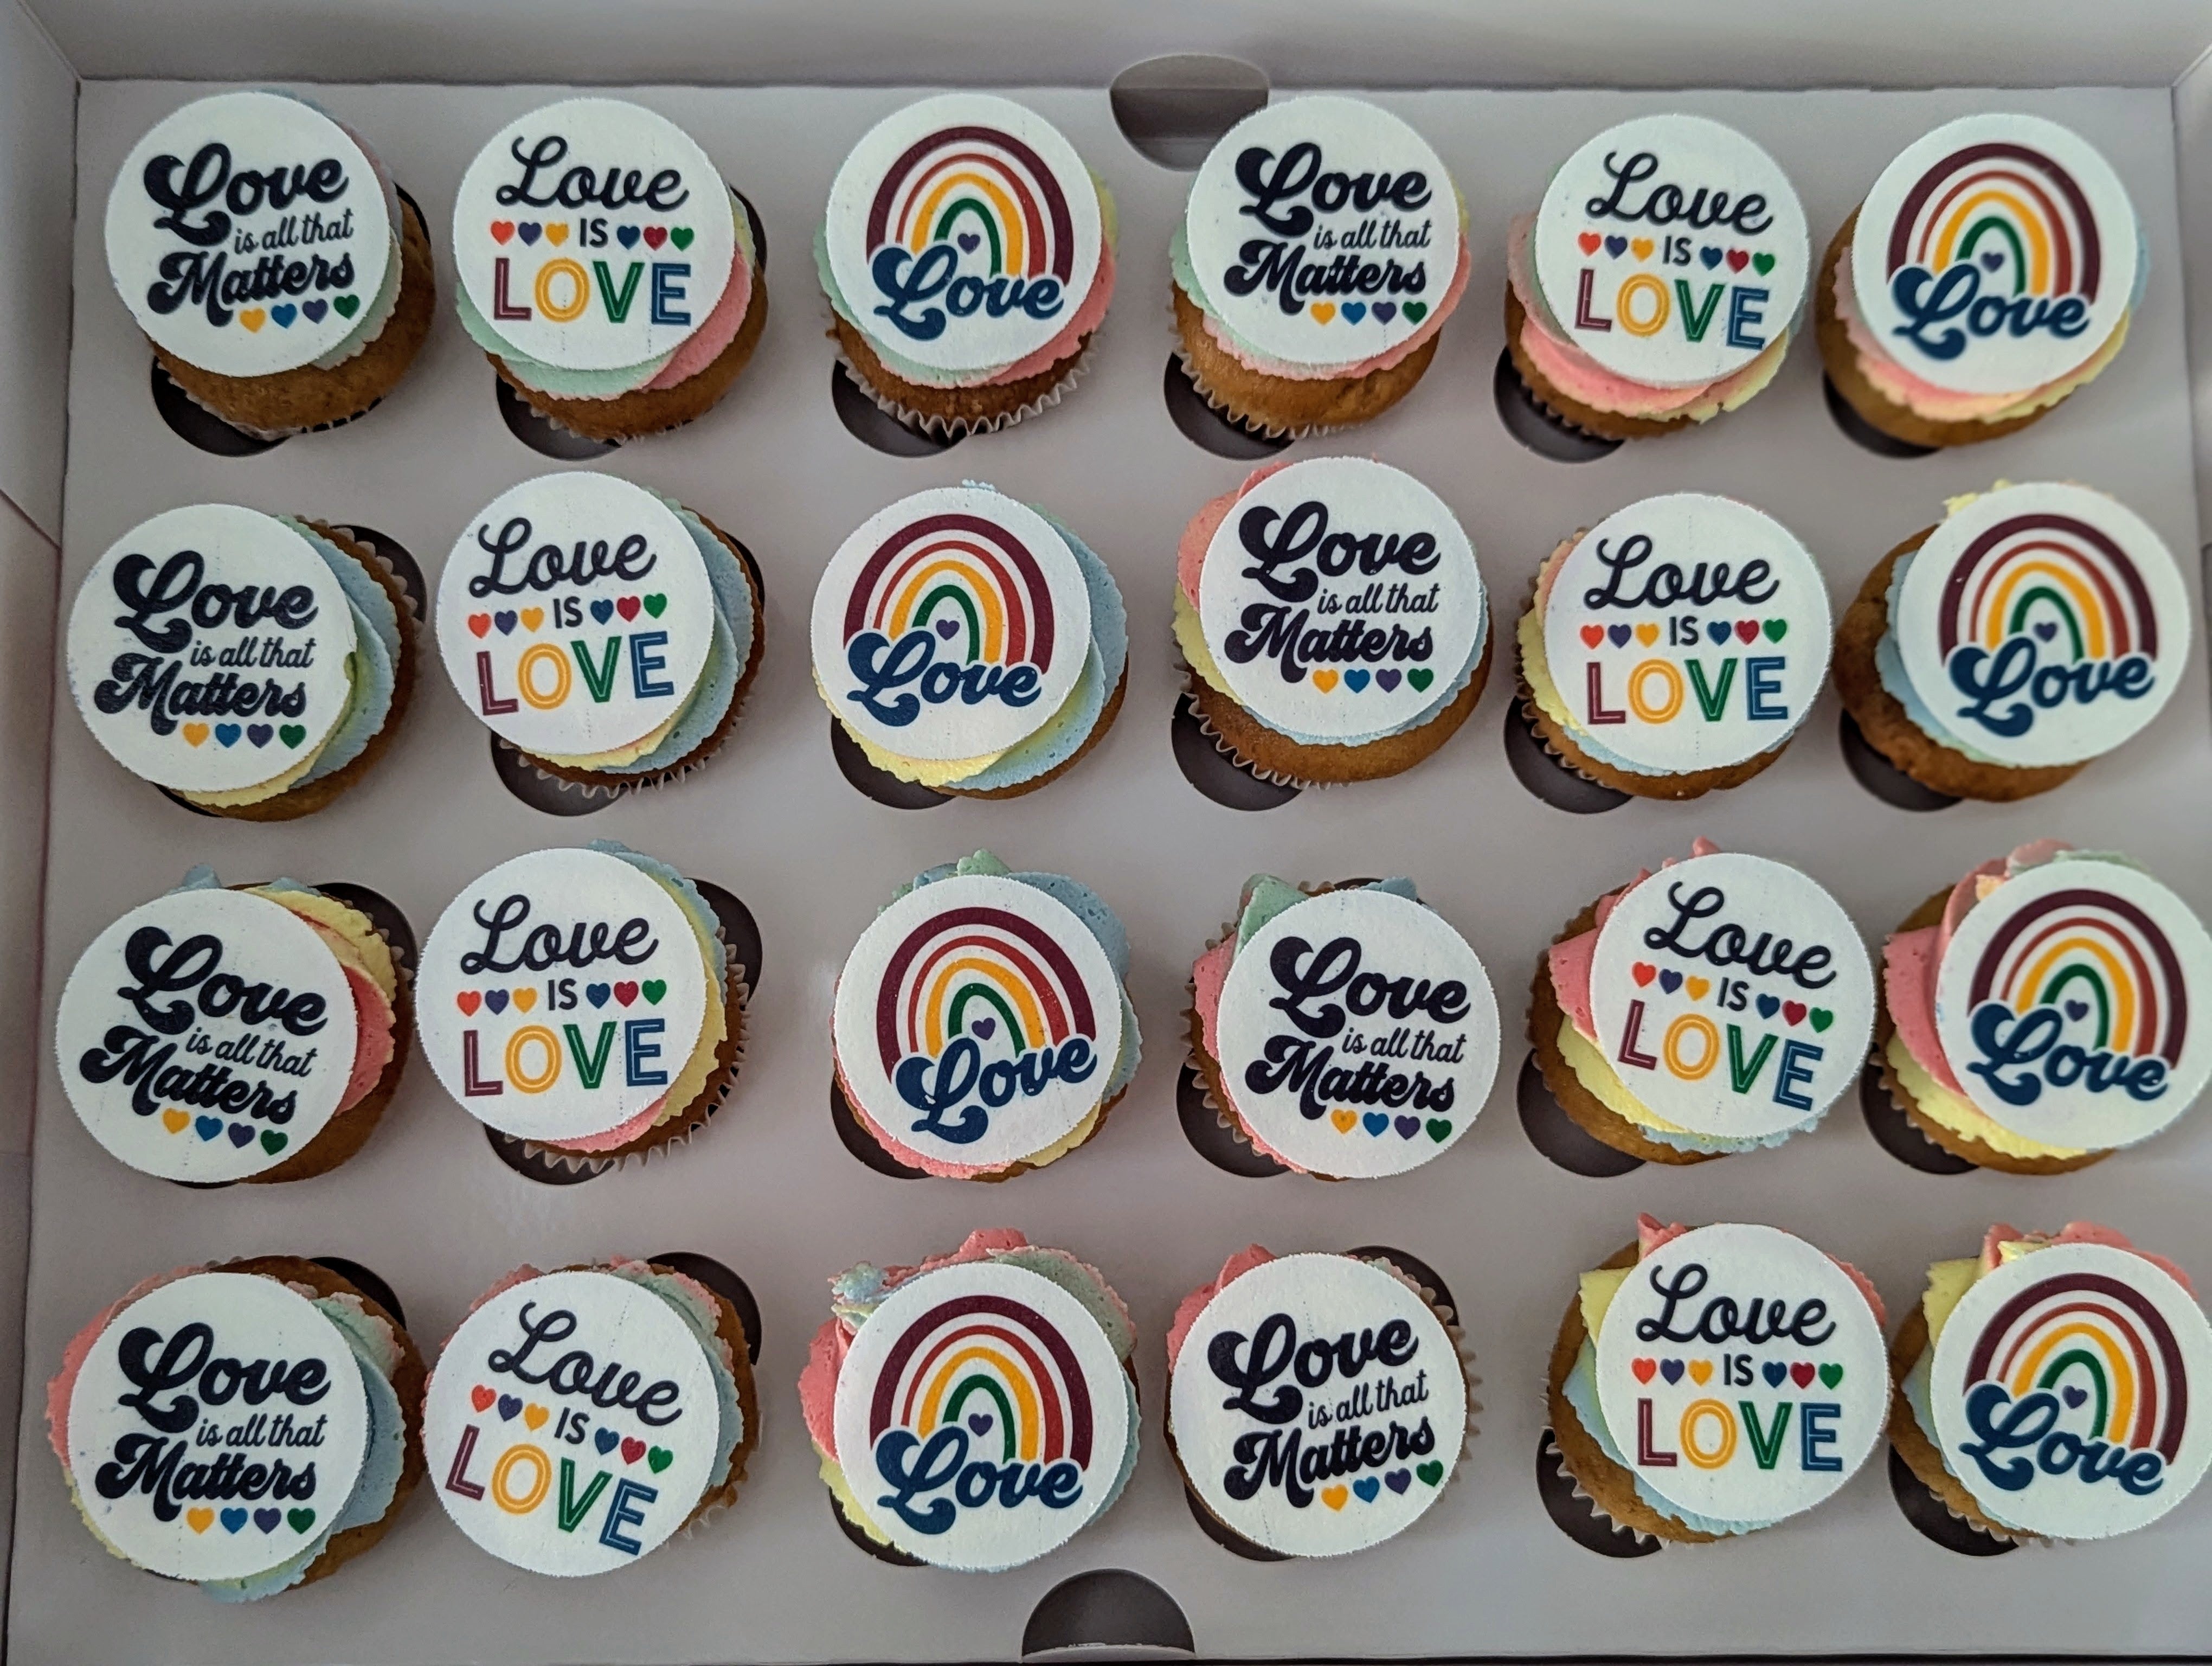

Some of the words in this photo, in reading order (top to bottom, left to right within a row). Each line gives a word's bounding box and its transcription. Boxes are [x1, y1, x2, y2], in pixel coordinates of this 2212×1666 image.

[143, 143, 349, 247] Love
[496, 136, 689, 212] Love
[1235, 142, 1432, 239] Love
[1586, 152, 1773, 236] Love
[234, 228, 259, 255] is
[261, 215, 299, 251] all
[301, 208, 353, 245] that
[580, 218, 608, 248] IS
[1314, 225, 1338, 249] is
[1341, 220, 1377, 249] all
[1380, 219, 1431, 248] that
[1663, 236, 1692, 266] IS
[147, 251, 355, 327] Matters
[494, 258, 691, 326] LOVE
[872, 245, 1064, 341] Love
[1224, 239, 1426, 316] Matters
[1576, 268, 1770, 350] LOVE
[1892, 263, 2089, 361] Love
[469, 517, 657, 598] Love
[1239, 501, 1441, 603] Love
[1584, 535, 1779, 610] Love
[113, 550, 318, 653] Love
[554, 596, 583, 629] IS
[1317, 588, 1342, 614] is
[1346, 583, 1383, 614] all
[1385, 583, 1440, 613] that
[1670, 616, 1699, 646] IS
[190, 640, 216, 667] is
[218, 636, 259, 667] all
[259, 637, 316, 668] that
[477, 631, 674, 715] LOVE
[847, 630, 1041, 727] Love
[1224, 603, 1433, 683] Matters
[94, 652, 306, 736] Matters
[1587, 656, 1788, 725] LOVE
[1949, 637, 2155, 738] Love
[460, 894, 659, 975] Love
[1644, 881, 1836, 989] Love
[117, 926, 328, 1036] Love
[548, 978, 577, 1010] IS
[1269, 937, 1471, 1039] Love
[1717, 977, 1750, 1011] IS
[79, 1025, 298, 1125] Matters
[185, 1027, 214, 1055] is
[214, 1033, 261, 1065] all
[256, 1039, 318, 1077] that
[464, 1018, 667, 1097] LOVE
[1245, 1035, 1455, 1120] Matters
[1342, 1027, 1367, 1054] is
[1371, 1027, 1410, 1058] all
[1410, 1030, 1467, 1063] that
[1618, 999, 1824, 1111] LOVE
[1966, 1004, 2168, 1106] Love
[896, 1036, 1097, 1144] Love
[1636, 1264, 1836, 1347] Love
[118, 1322, 331, 1434] Love
[488, 1302, 682, 1426] Love
[1207, 1313, 1419, 1425] Love
[1308, 1402, 1333, 1430] is
[1336, 1382, 1373, 1422] all
[1375, 1369, 1429, 1412] that
[1724, 1354, 1753, 1387] IS
[196, 1418, 223, 1447] is
[226, 1413, 267, 1447] all
[268, 1413, 327, 1447] that
[554, 1407, 590, 1444] IS
[1224, 1416, 1435, 1506] Matters
[1638, 1398, 1843, 1472] LOVE
[1959, 1384, 2163, 1496] Love
[95, 1433, 316, 1522] Matters
[445, 1425, 658, 1556] LOVE
[876, 1426, 1083, 1535] Love
